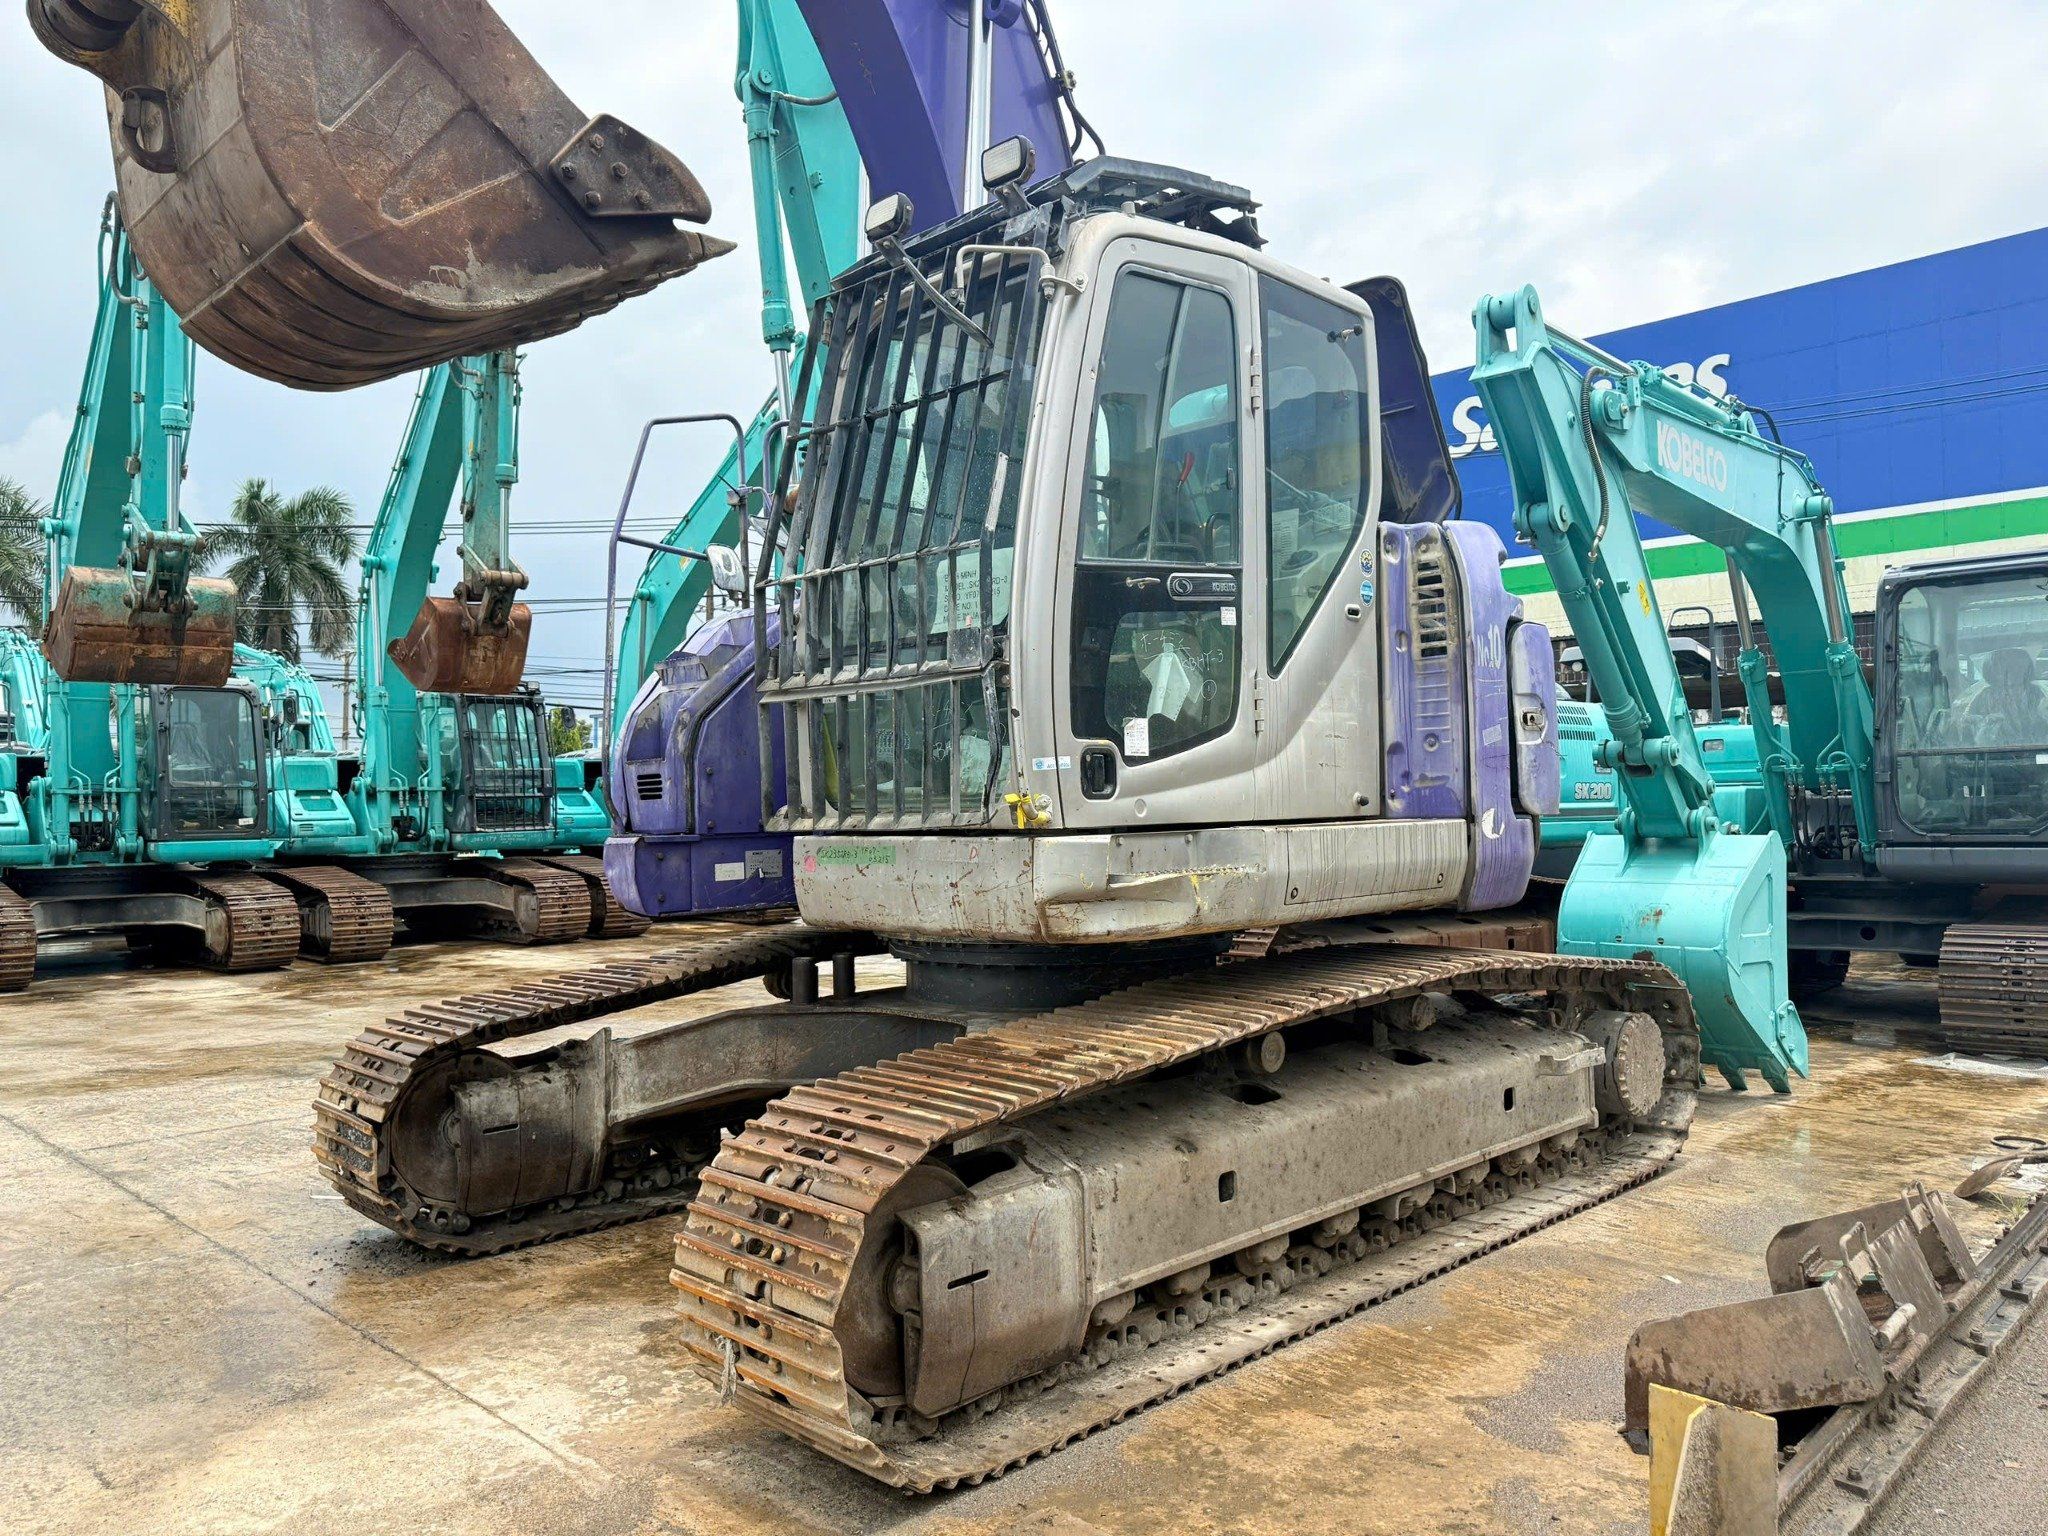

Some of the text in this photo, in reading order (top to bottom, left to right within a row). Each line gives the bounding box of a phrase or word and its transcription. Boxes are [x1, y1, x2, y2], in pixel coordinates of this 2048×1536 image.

[1656, 419, 1728, 492] KOBELCO
[1212, 582, 1237, 592] KOBELCO
[1574, 782, 1613, 800] SK200
